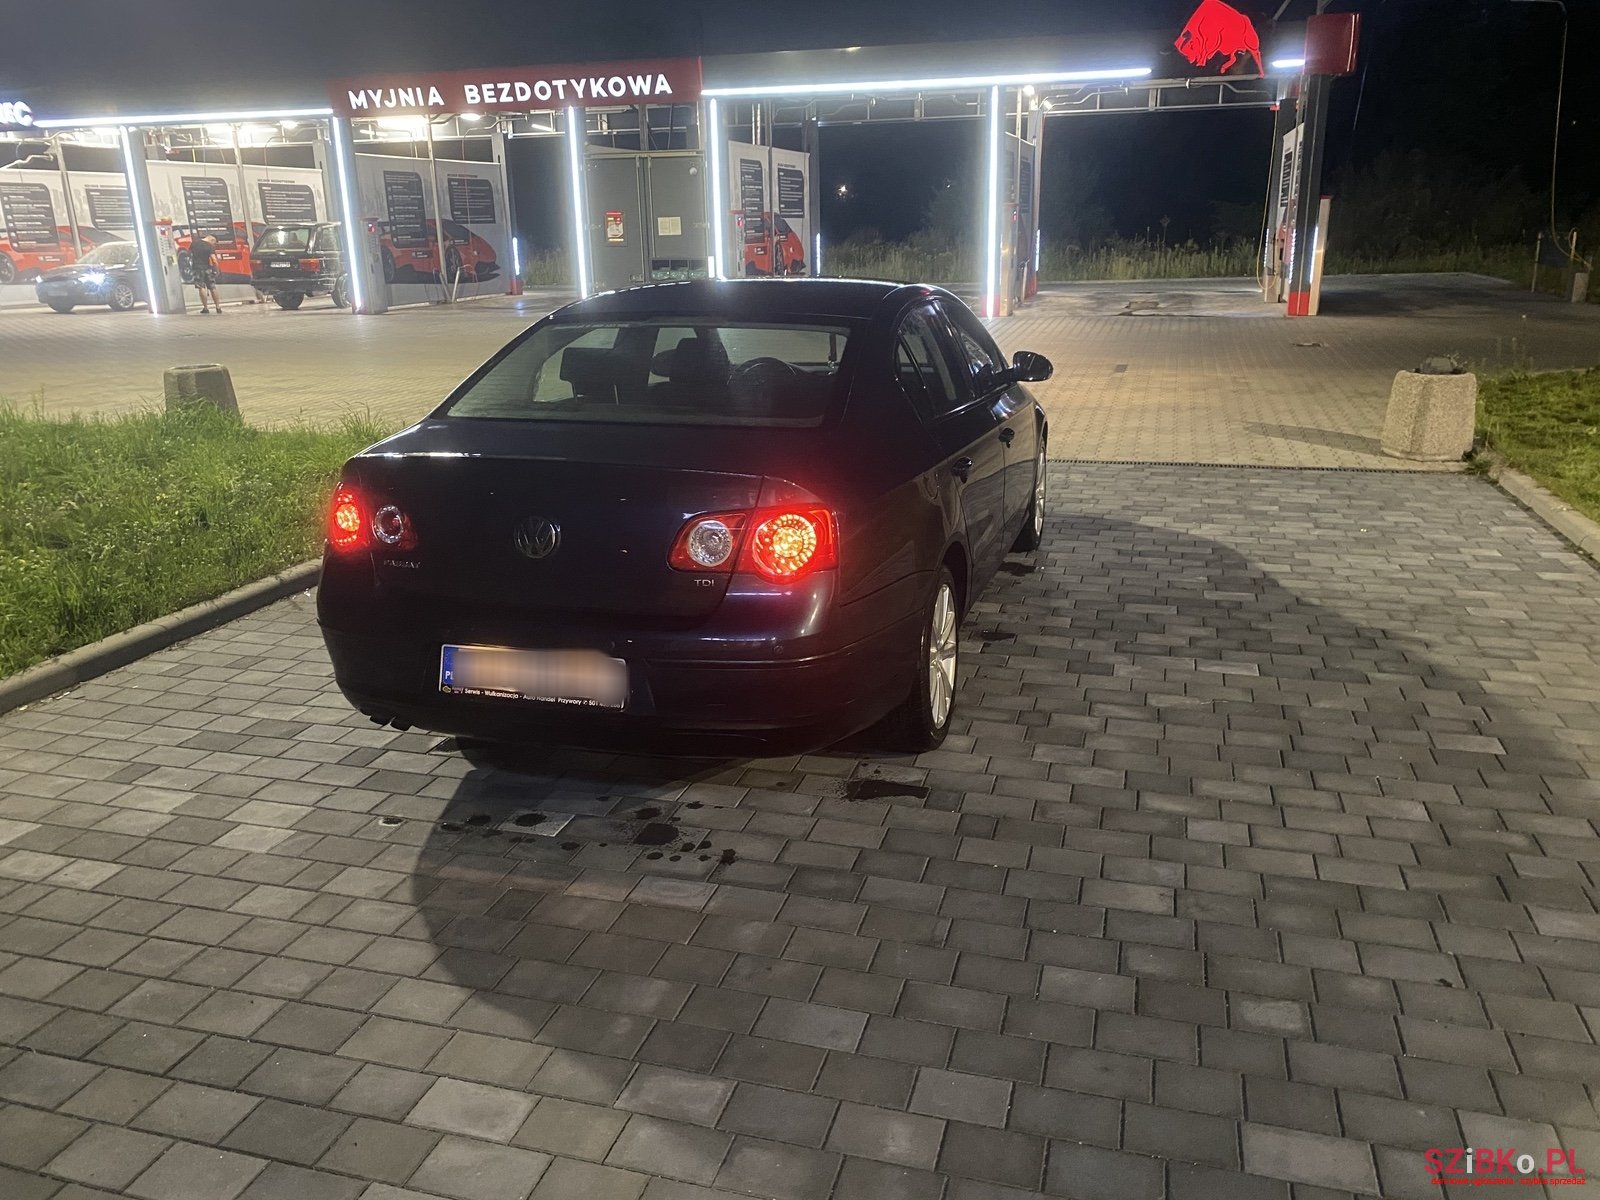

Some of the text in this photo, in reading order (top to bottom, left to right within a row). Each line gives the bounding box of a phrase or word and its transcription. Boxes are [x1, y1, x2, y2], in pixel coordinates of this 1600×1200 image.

[347, 74, 673, 110] MYJNIA BEZDOTYKOWA
[693, 579, 715, 587] TDI
